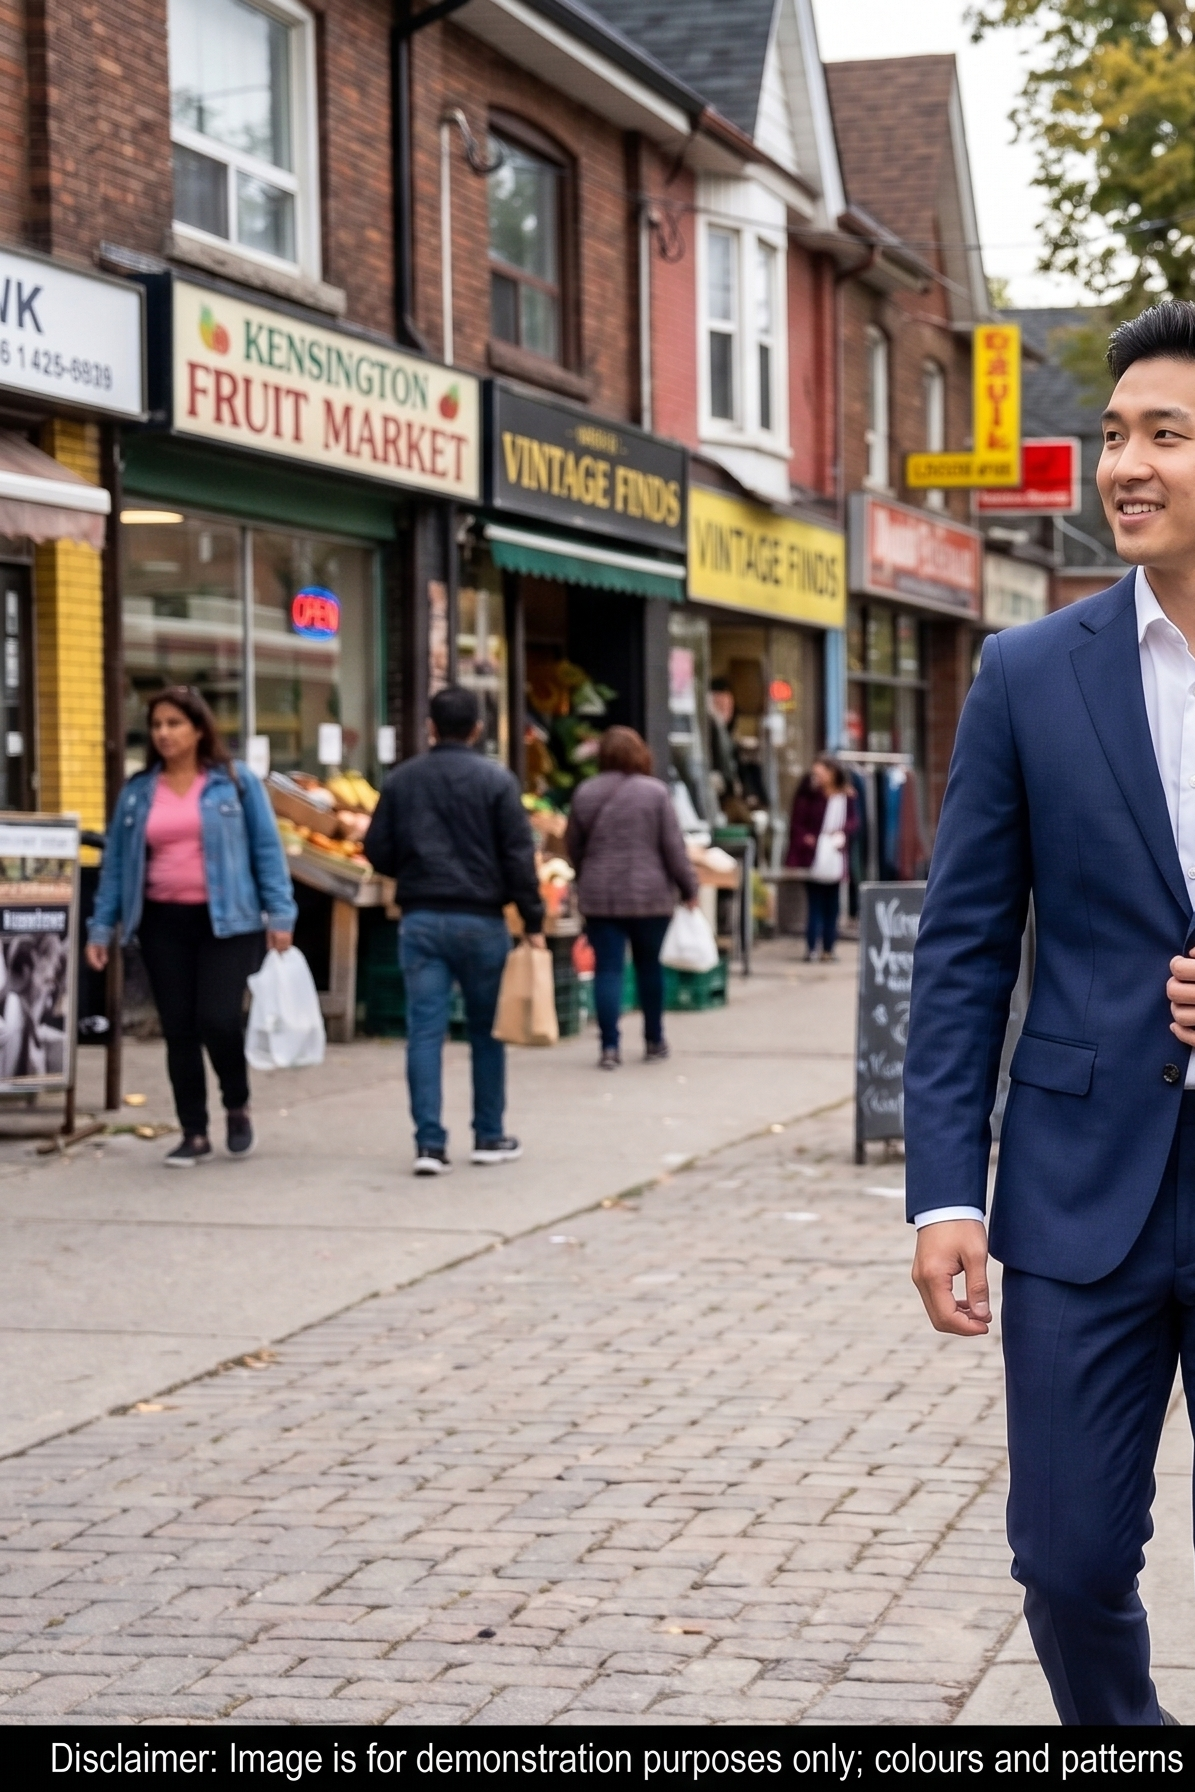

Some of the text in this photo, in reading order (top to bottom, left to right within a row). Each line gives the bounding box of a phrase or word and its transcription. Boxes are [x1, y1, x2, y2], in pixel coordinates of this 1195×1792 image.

[243, 318, 429, 411] KENSINGTON
[186, 361, 469, 483] FRUIT MARKET
[502, 431, 611, 510] VINTAGE
[614, 464, 681, 528] FINDS
[694, 517, 781, 587] VINTAGE
[786, 544, 839, 599] FINDS
[292, 594, 340, 633] OPEN
